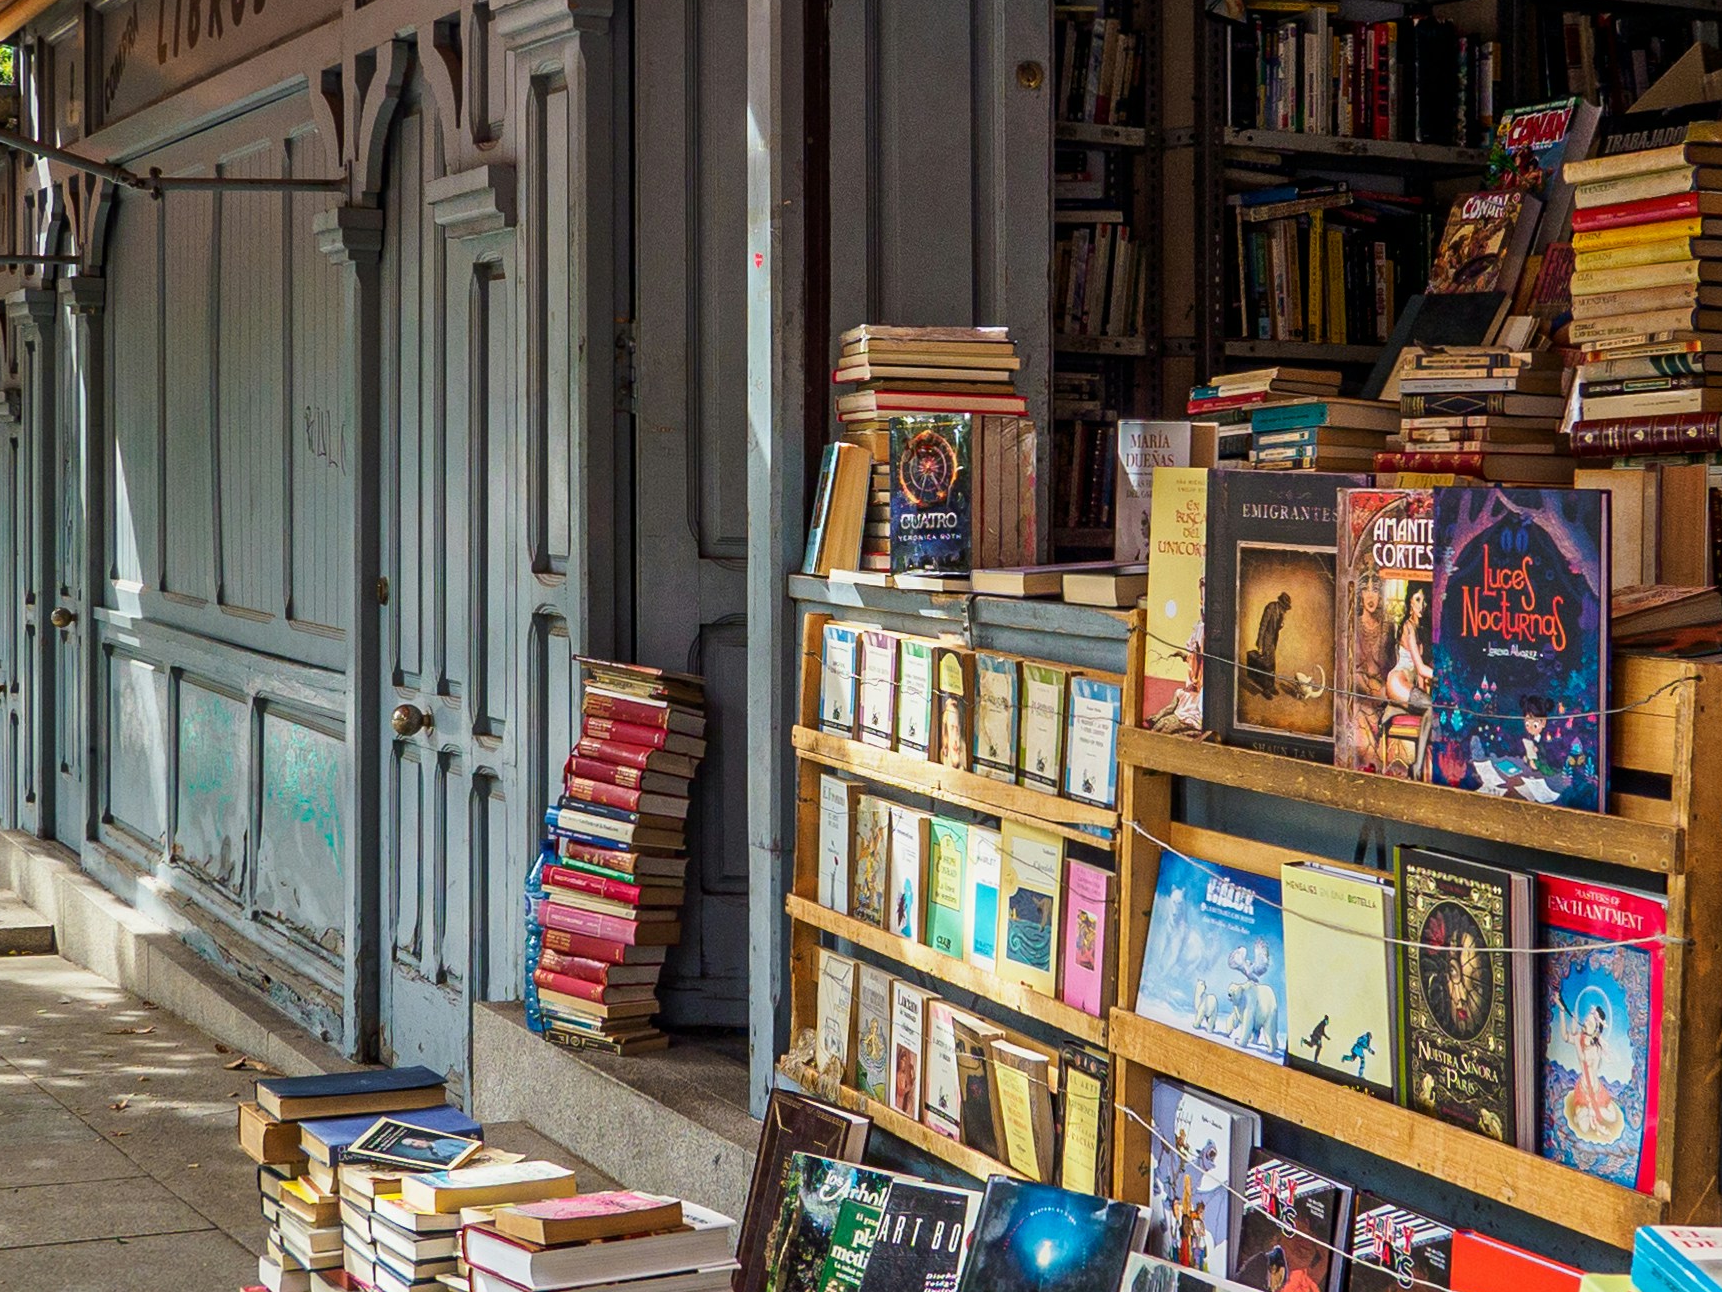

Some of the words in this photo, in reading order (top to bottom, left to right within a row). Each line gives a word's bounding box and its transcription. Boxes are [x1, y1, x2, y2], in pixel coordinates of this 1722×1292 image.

[104, 1, 139, 114] COMPRA
[1506, 107, 1573, 148] CONAN
[1462, 193, 1509, 222] CONAN
[1130, 430, 1170, 450] MARÍA
[1125, 450, 1175, 468] DUEÑAS
[899, 511, 957, 531] CUATRO
[1242, 502, 1339, 523] EMIGRANTES
[897, 533, 937, 543] VERONICA
[939, 532, 962, 542] ROTH
[1483, 544, 1536, 611] Luces
[1461, 585, 1567, 652] Nocturnas
[1547, 895, 1644, 932] ENCHANTMENT
[877, 1214, 924, 1247] ART
